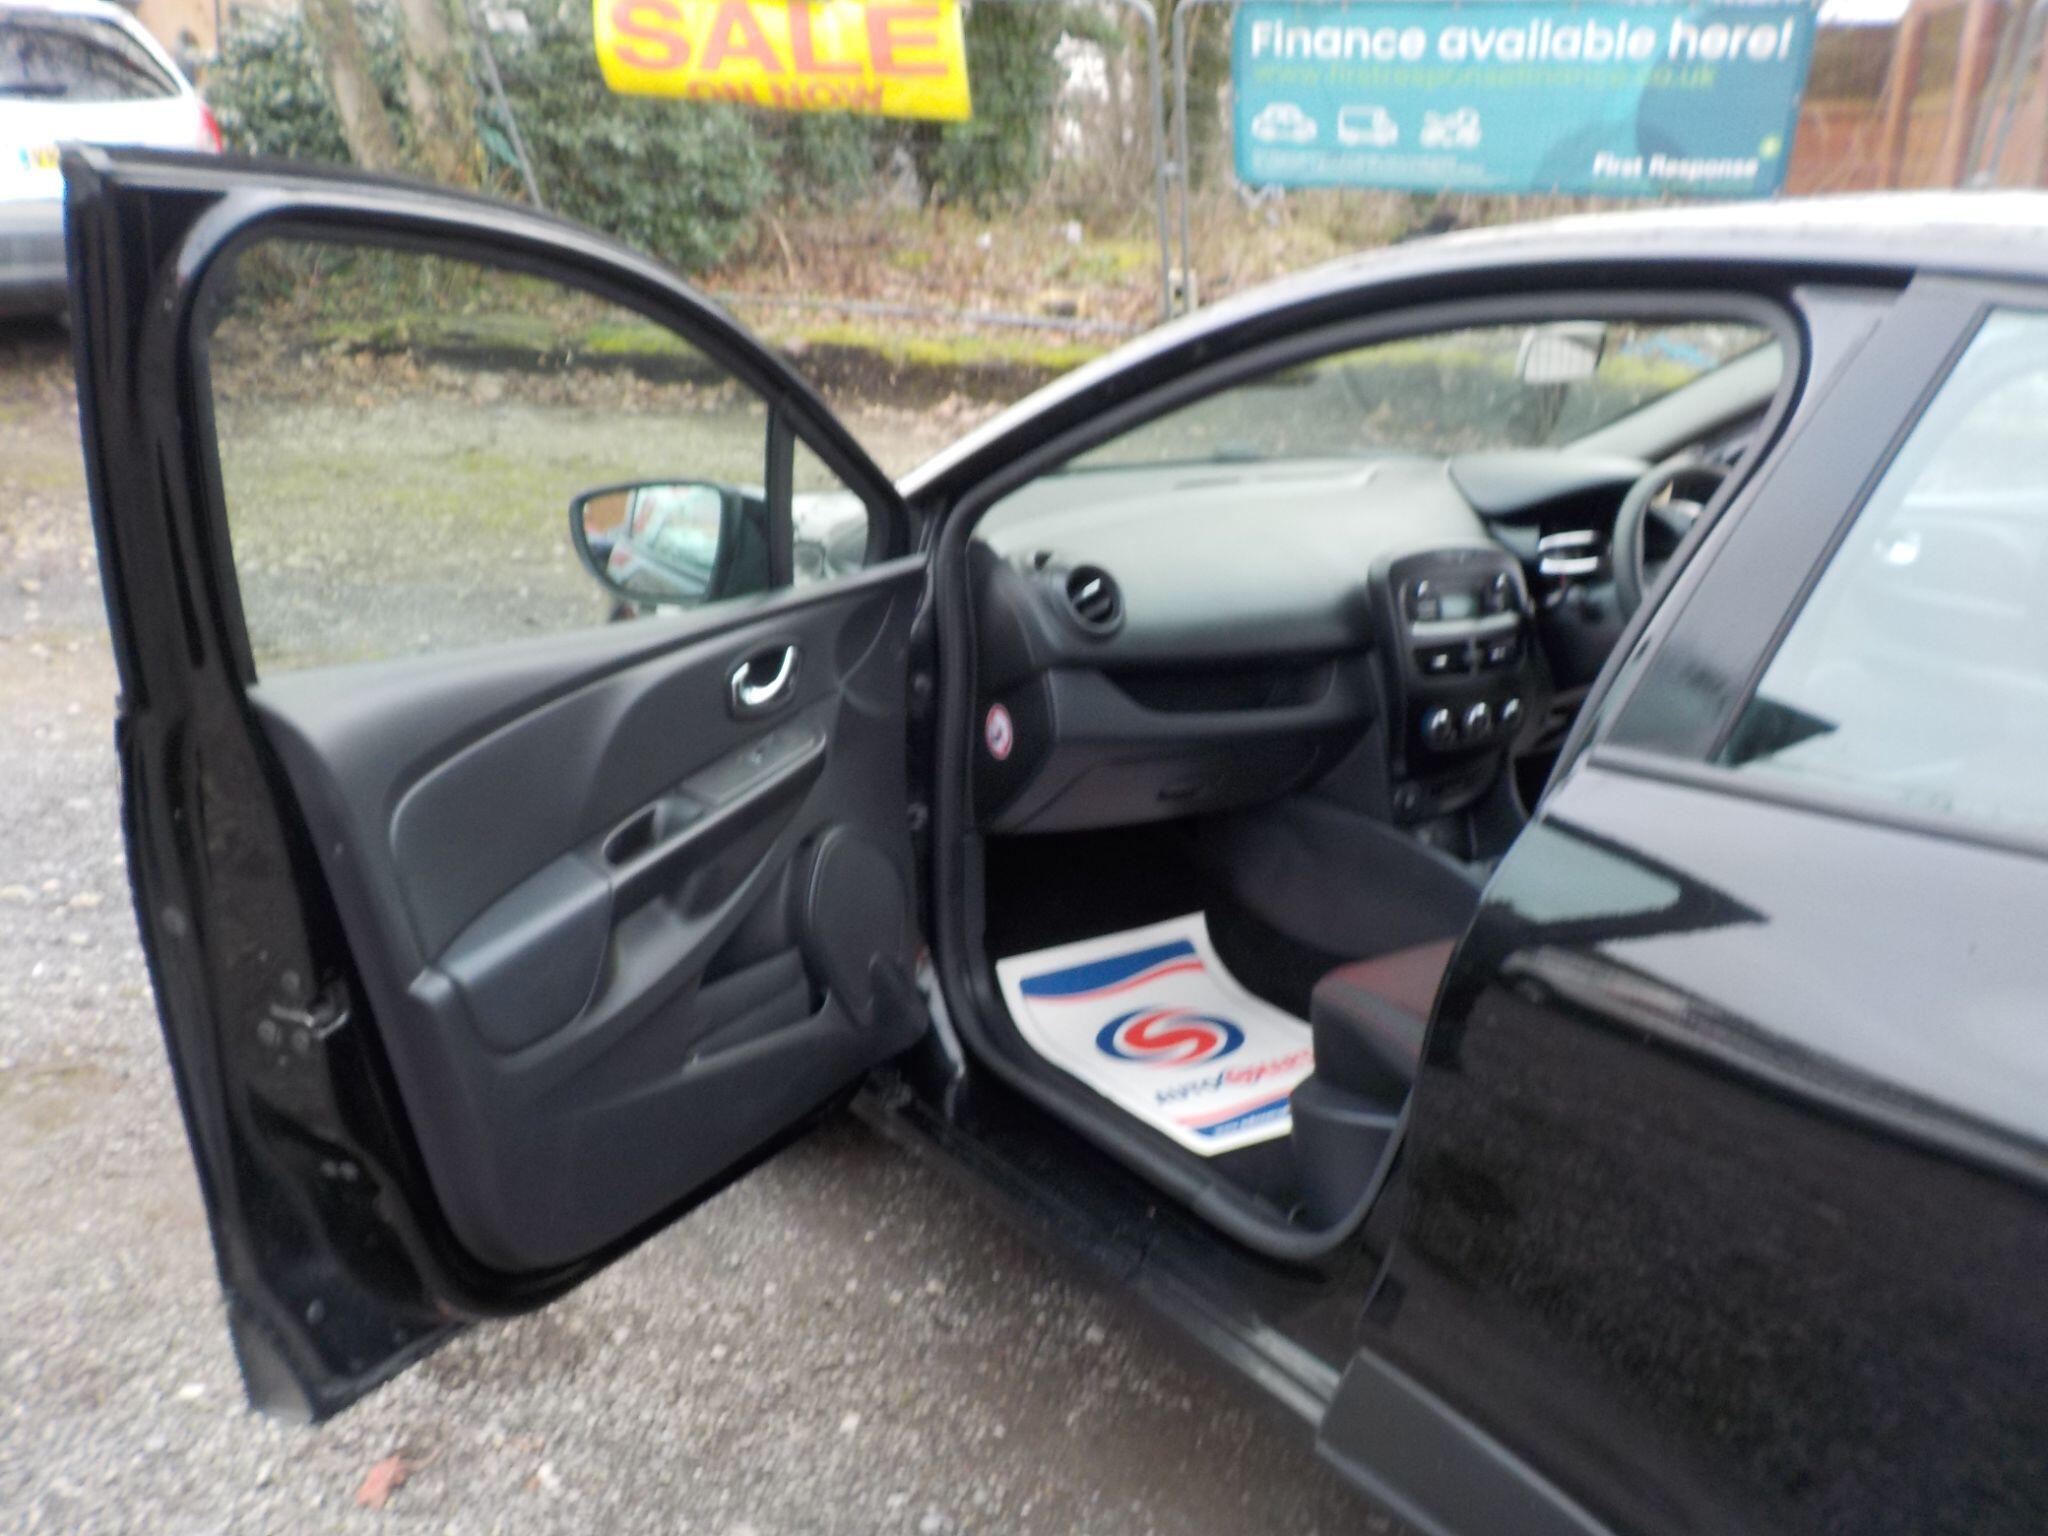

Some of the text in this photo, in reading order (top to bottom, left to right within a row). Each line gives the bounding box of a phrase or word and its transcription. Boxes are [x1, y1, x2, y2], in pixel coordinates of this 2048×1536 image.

[612, 0, 949, 76] SALE
[1250, 17, 1796, 62] Finance available here!
[1593, 152, 1759, 182] First Response
